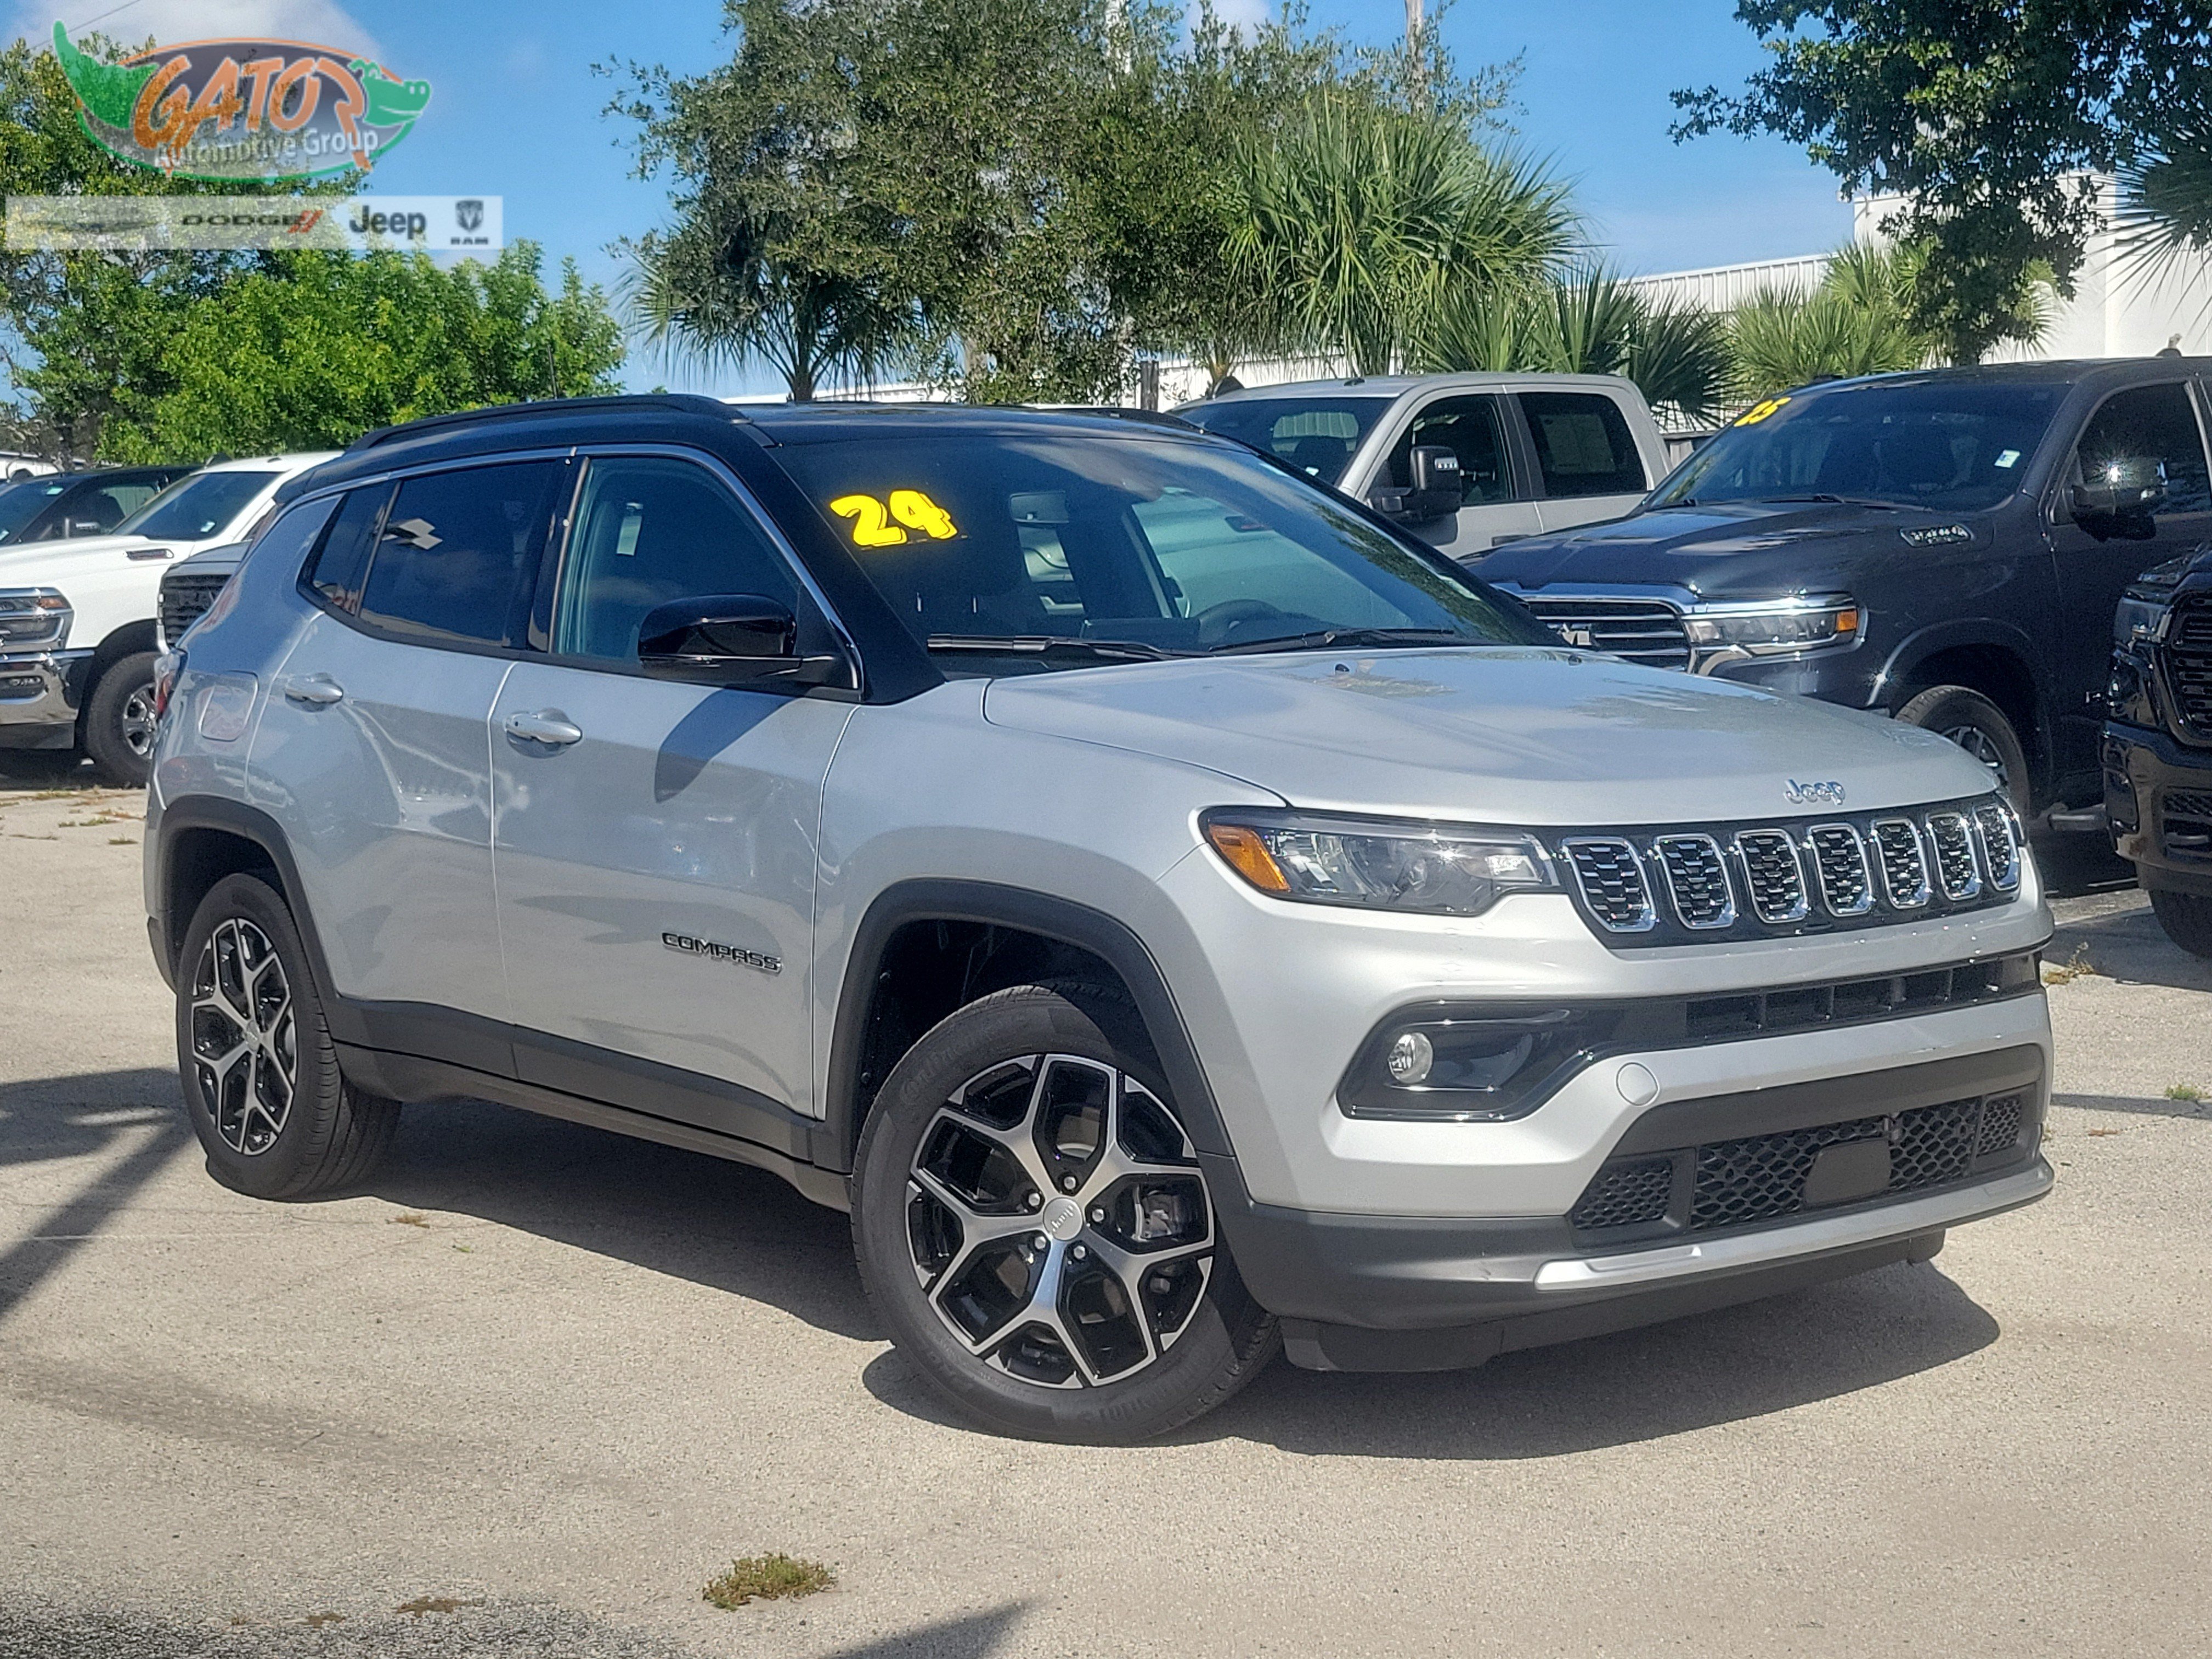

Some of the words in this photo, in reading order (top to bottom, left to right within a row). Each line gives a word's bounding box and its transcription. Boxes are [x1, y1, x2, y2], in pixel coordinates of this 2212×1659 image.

[830, 490, 958, 547] 24
[1784, 778, 1846, 805] Jeep
[662, 932, 783, 975] COMPASS
